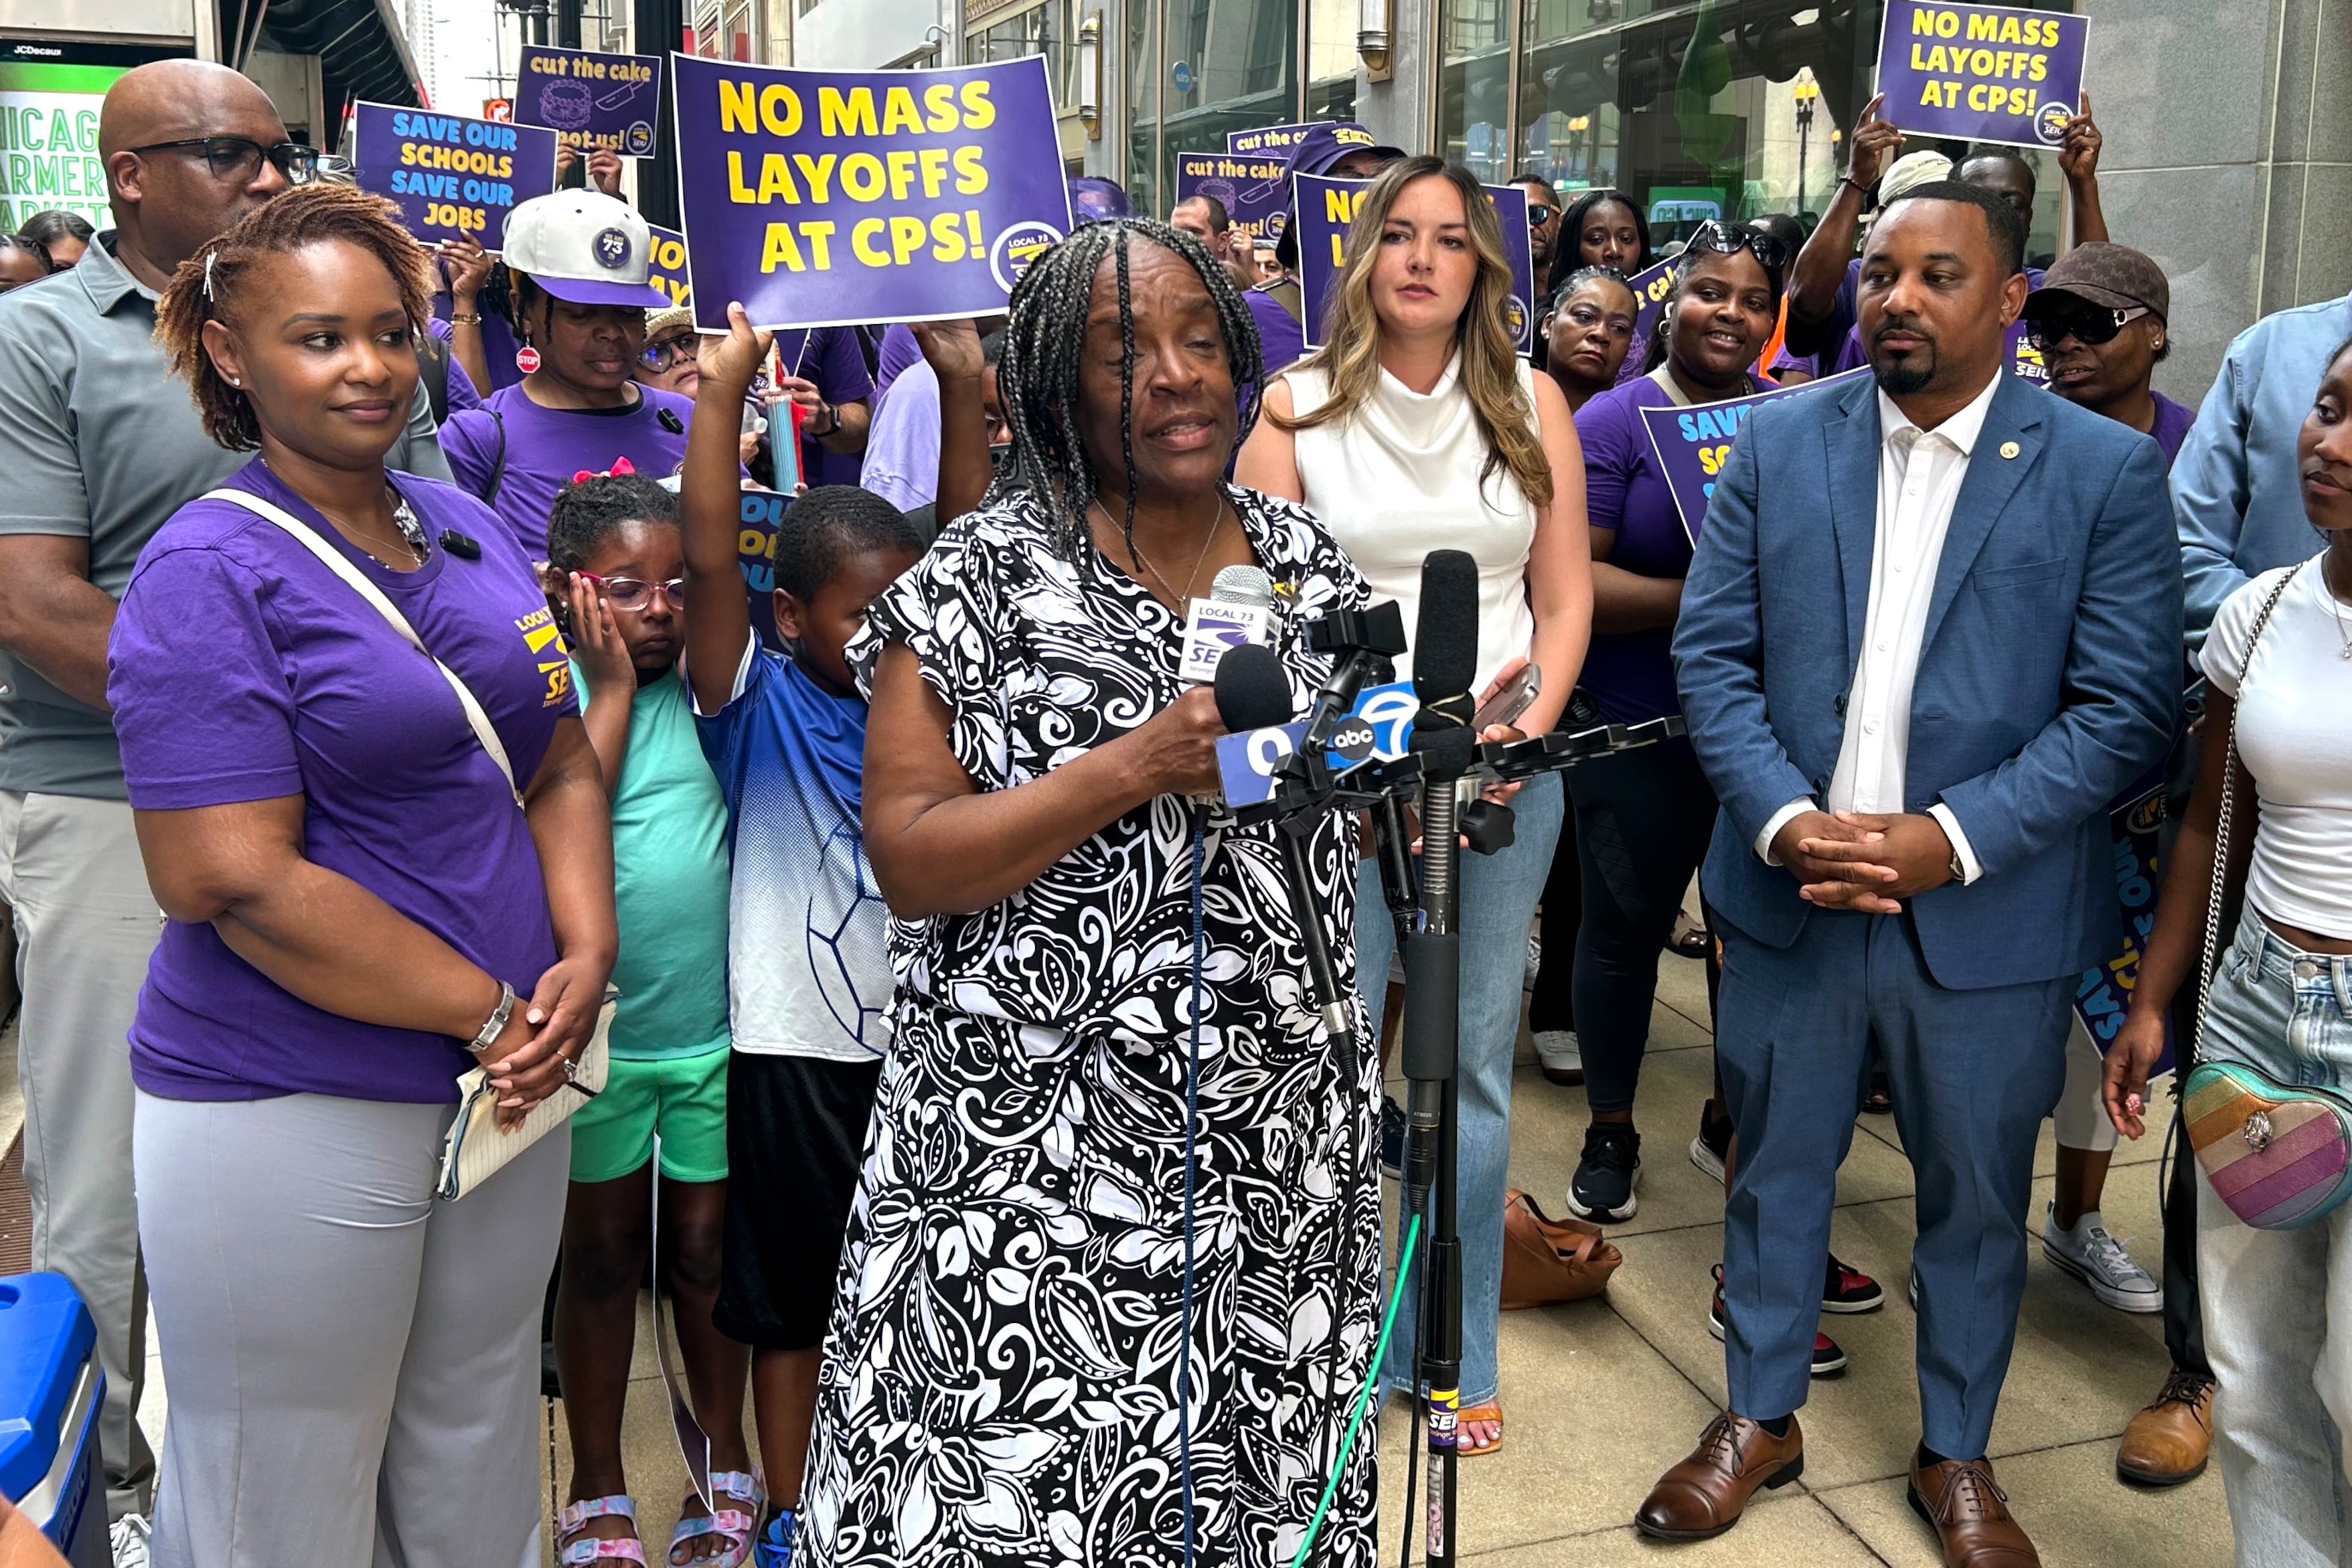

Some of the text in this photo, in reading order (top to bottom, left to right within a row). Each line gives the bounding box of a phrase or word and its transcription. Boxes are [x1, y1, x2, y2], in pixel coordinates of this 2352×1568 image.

[1912, 8, 2060, 48] NO MASS
[13, 45, 62, 56] JCDecaux
[1910, 43, 2048, 81] LAYOFFS
[530, 56, 652, 82] cut the cake
[718, 78, 996, 137] NO MASS
[1919, 80, 2037, 116] AT CPS!
[393, 112, 517, 152] SAVE OUR
[1236, 133, 1261, 151] cut
[1263, 130, 1291, 147] the
[400, 142, 514, 179] SCHOOLS
[726, 145, 990, 204] LAYOFFS
[1185, 161, 1213, 177] cut
[1217, 159, 1246, 178] the
[390, 170, 514, 207] SAVE OUR
[422, 202, 487, 232] JOBS
[603, 238, 623, 254] 73
[760, 209, 986, 273] AT CPS!
[1008, 233, 1049, 248] LOCAL 73
[518, 355, 538, 366] STOP
[1678, 404, 1752, 443] SAV
[1198, 607, 1255, 622] LOCAL 73
[1189, 647, 1221, 664] SE
[1334, 729, 1374, 748] abc
[1429, 1413, 1458, 1430] SEI
